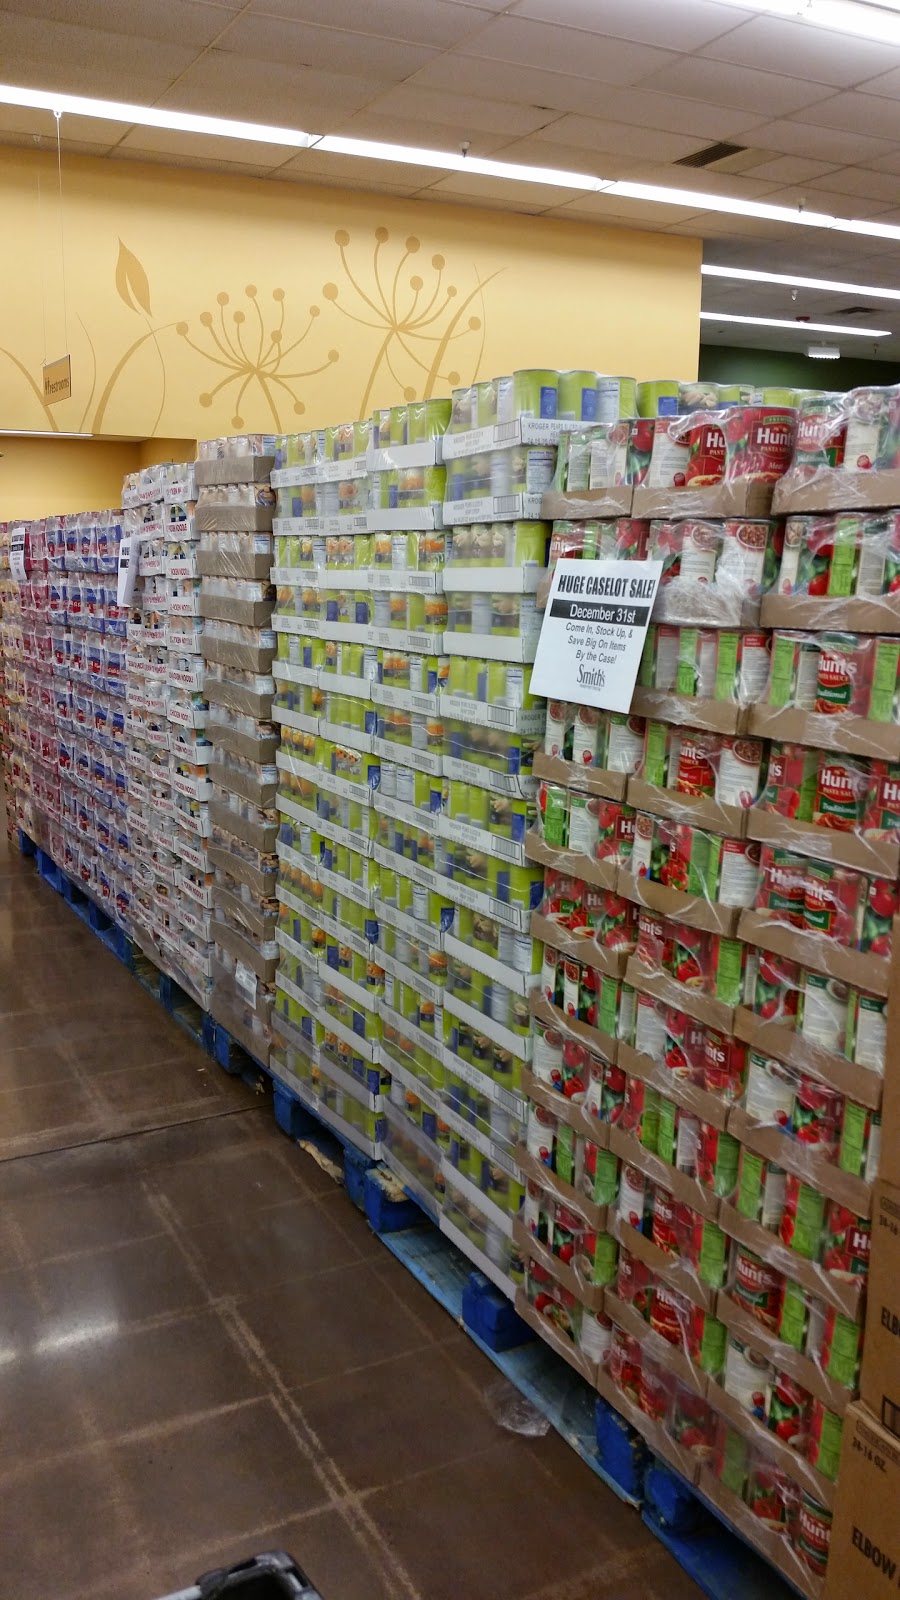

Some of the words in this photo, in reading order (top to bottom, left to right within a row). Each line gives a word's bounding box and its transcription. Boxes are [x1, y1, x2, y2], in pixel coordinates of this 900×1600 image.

[49, 377, 70, 394] restrooms
[528, 422, 549, 430] KROGER
[557, 574, 586, 594] HUGE
[586, 577, 628, 598] CASELOT
[629, 579, 656, 599] SALE!
[570, 604, 615, 621] December
[616, 608, 636, 623] 31st
[565, 622, 585, 633] Come
[595, 625, 615, 636] Stock
[617, 628, 627, 639] Up,
[568, 635, 584, 646] Save
[585, 636, 597, 649] Big
[598, 639, 608, 649] On
[609, 641, 626, 652] Items
[575, 650, 586, 661] By
[586, 651, 597, 661] the
[598, 652, 617, 664] Case!
[852, 1526, 896, 1580] ELBOW
